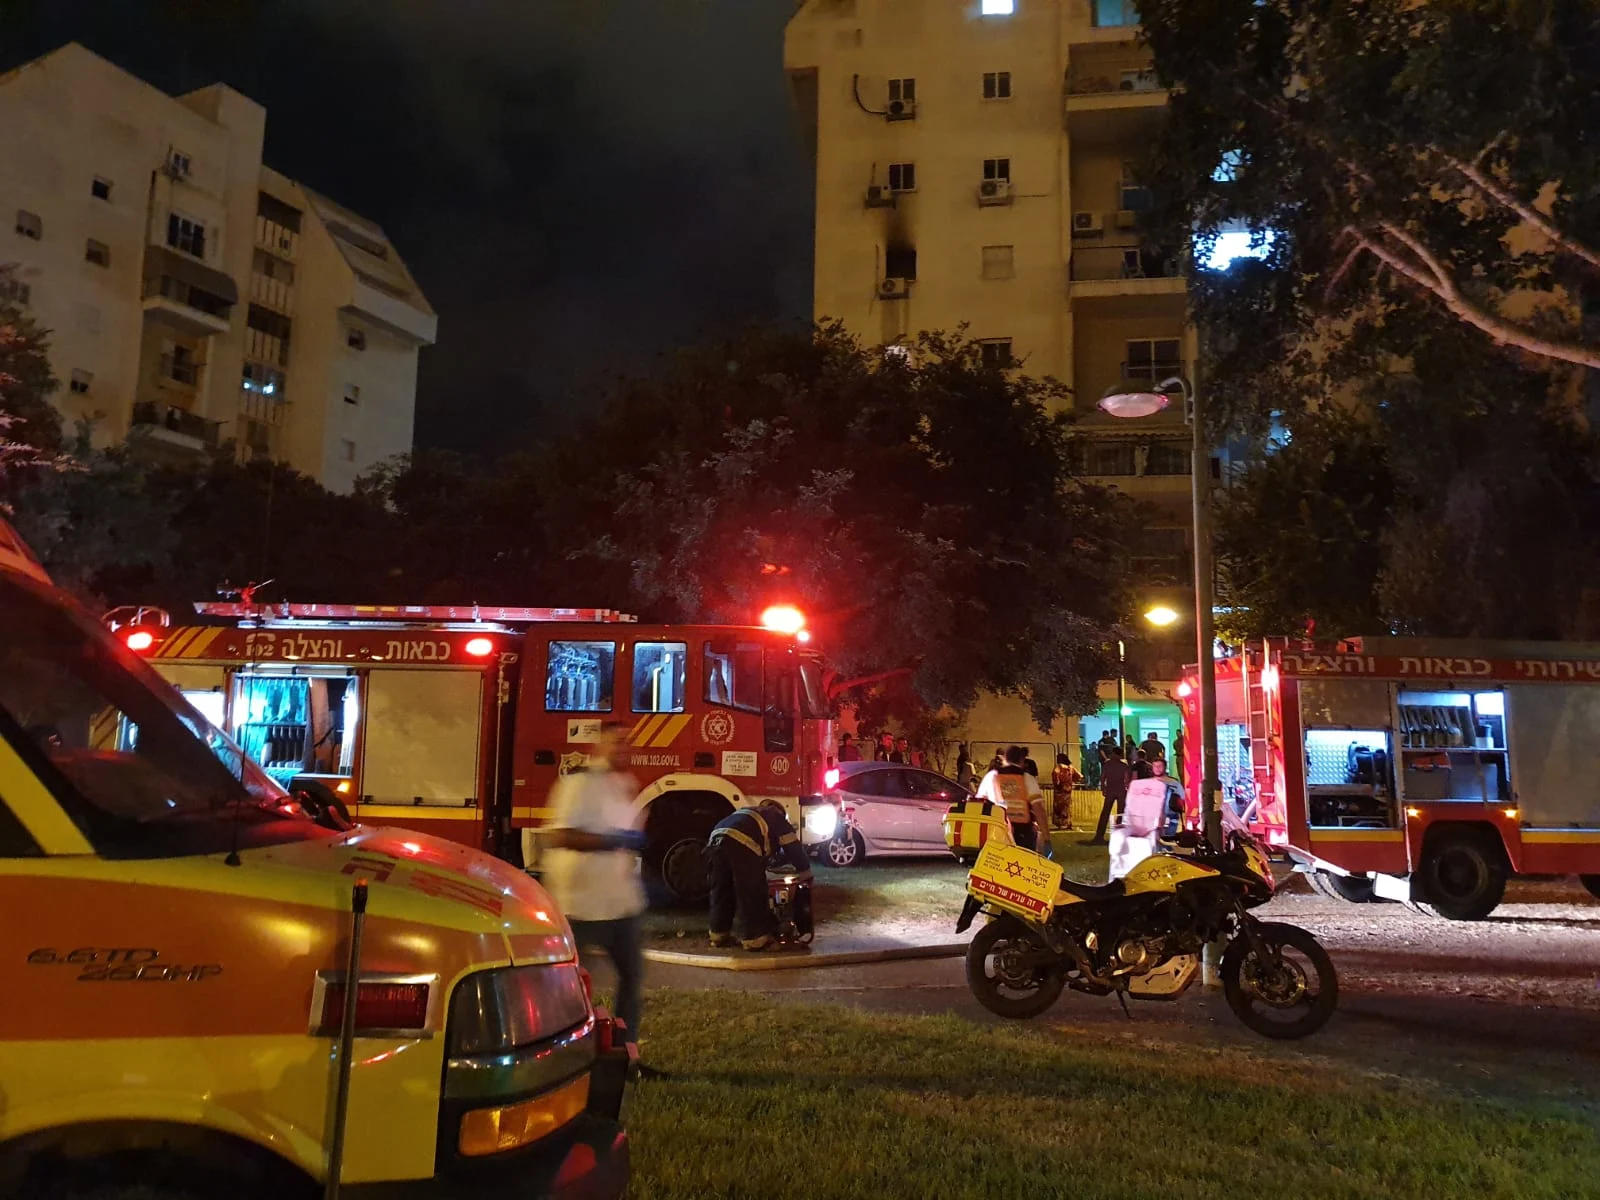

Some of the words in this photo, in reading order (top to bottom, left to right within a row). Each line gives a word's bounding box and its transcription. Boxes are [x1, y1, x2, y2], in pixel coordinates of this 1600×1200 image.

[245, 643, 275, 657] 102
[281, 632, 342, 659] והצלה
[385, 640, 451, 661] כבאות
[1283, 651, 1376, 673] והצלה
[1399, 656, 1493, 676] כבאות
[772, 759, 788, 772] 400
[1026, 866, 1038, 874] דוד
[1031, 874, 1049, 884] אדום
[979, 880, 996, 893] חיים
[997, 884, 1009, 897] של
[1026, 897, 1037, 908] זה
